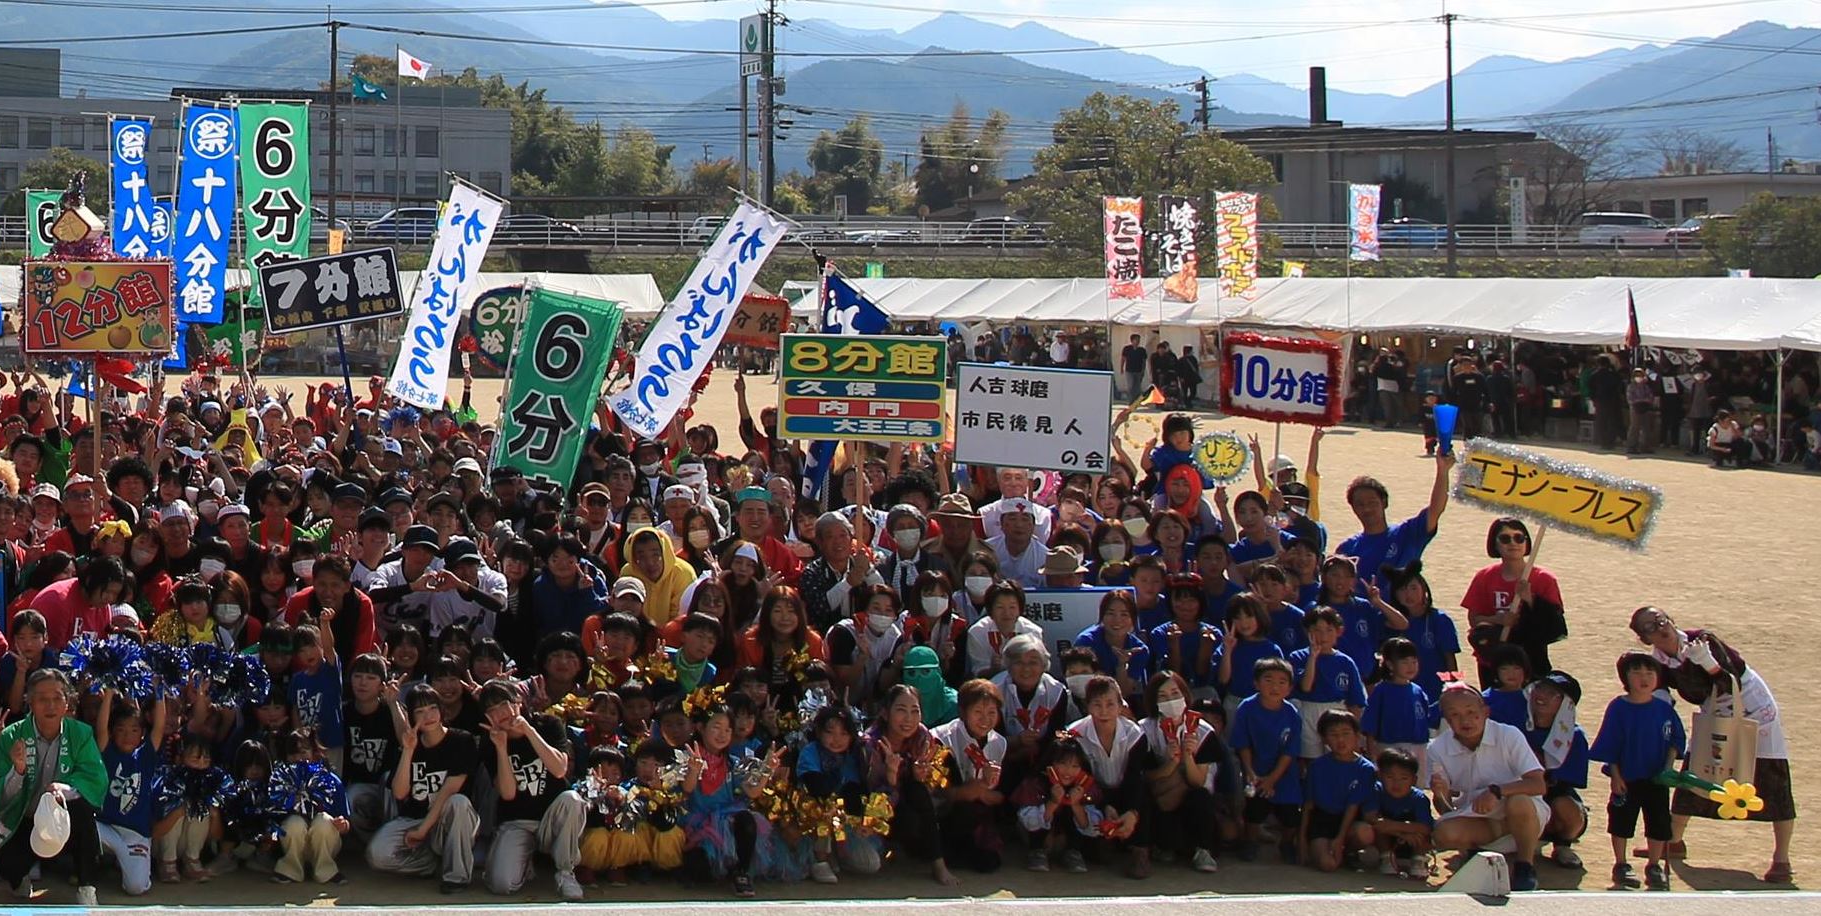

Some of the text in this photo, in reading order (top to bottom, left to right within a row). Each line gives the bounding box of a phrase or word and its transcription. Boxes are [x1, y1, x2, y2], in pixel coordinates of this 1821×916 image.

[249, 116, 308, 267] 6分
[180, 168, 227, 314] 十八分館
[1112, 215, 1139, 281] たこ焼
[268, 254, 391, 310] 7分館
[34, 270, 164, 346] 12分館
[789, 340, 940, 377] 8分館
[796, 380, 877, 397] 久保
[969, 375, 1049, 399] 人吉球磨
[1232, 353, 1329, 406] 10分館
[508, 311, 590, 494] 6分
[818, 400, 900, 417] 内門
[832, 418, 933, 436] 大王三条
[961, 410, 1083, 436] 市民後見人
[1061, 449, 1105, 469] の会
[1202, 439, 1240, 459] ひろ
